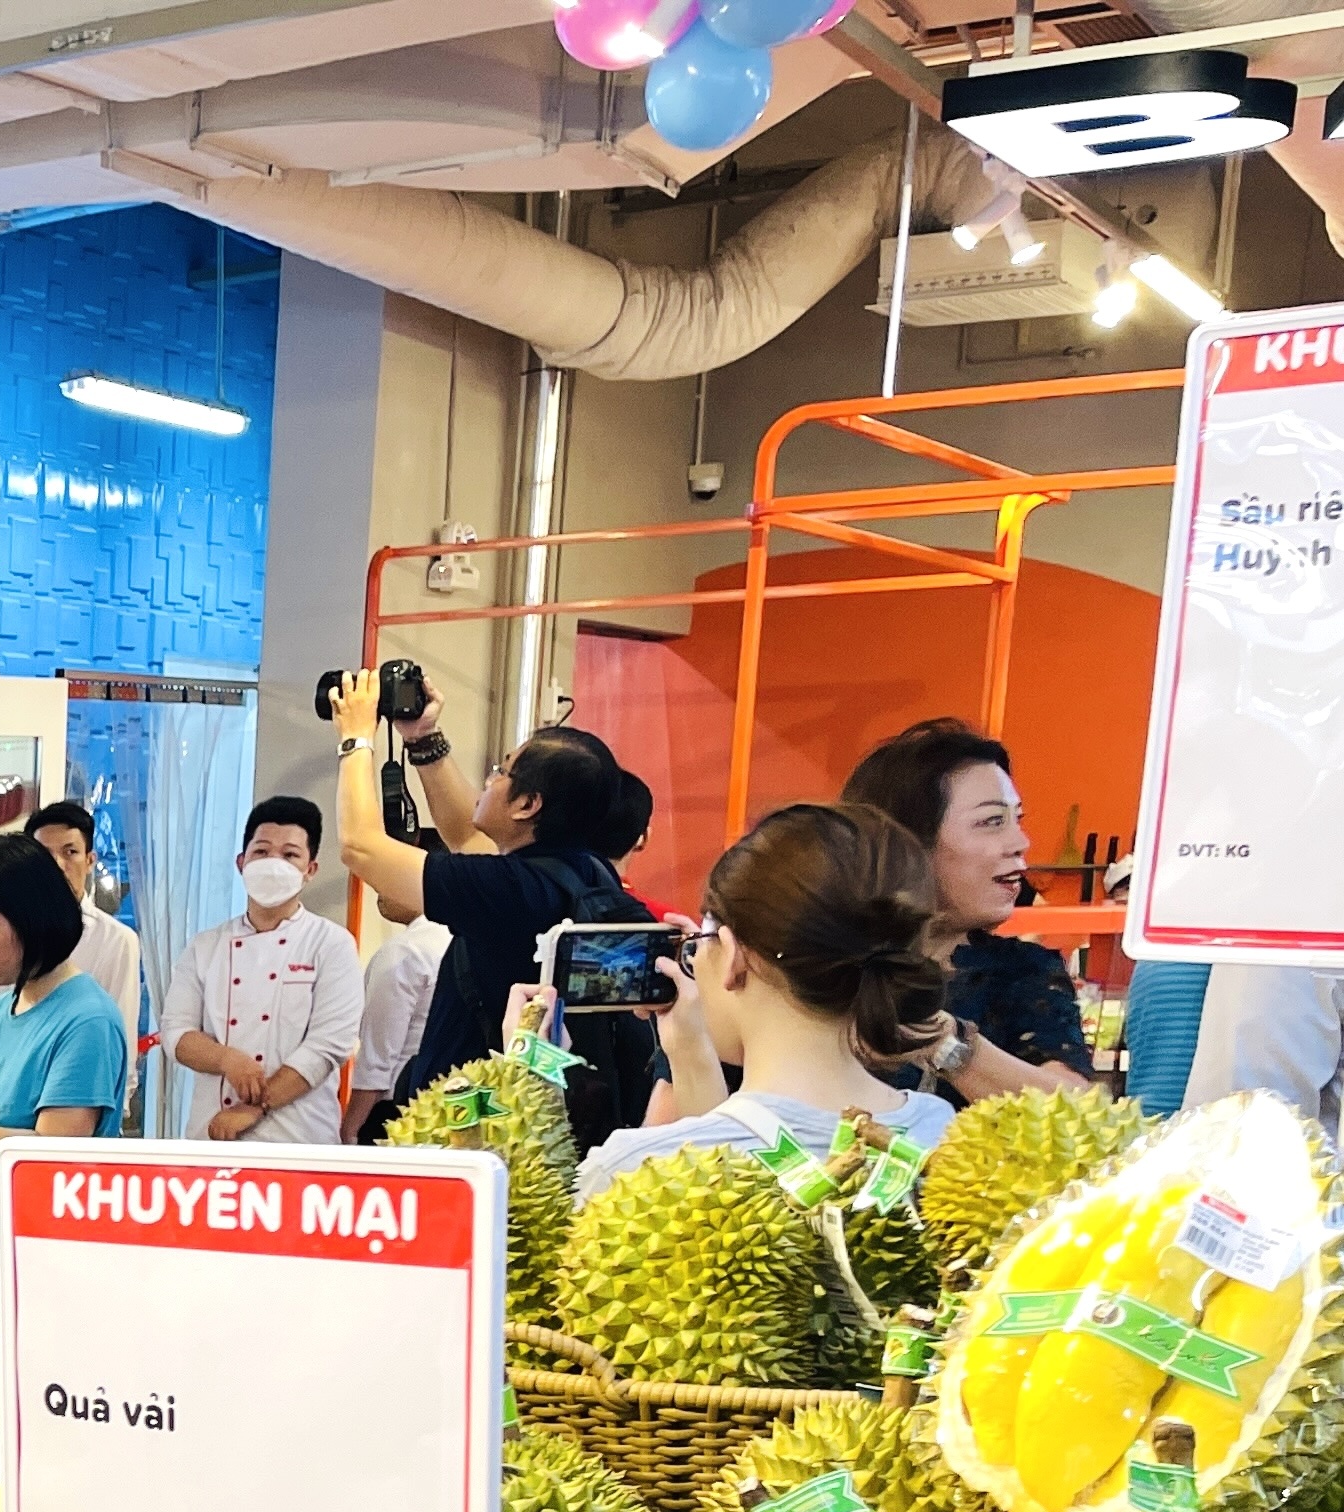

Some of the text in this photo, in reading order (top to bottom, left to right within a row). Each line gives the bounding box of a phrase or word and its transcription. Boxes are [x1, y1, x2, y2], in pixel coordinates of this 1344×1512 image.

[1225, 843, 1250, 858] KG
[51, 1168, 419, 1254] KHUYẾN MẠI
[44, 1383, 175, 1432] Quả vải
